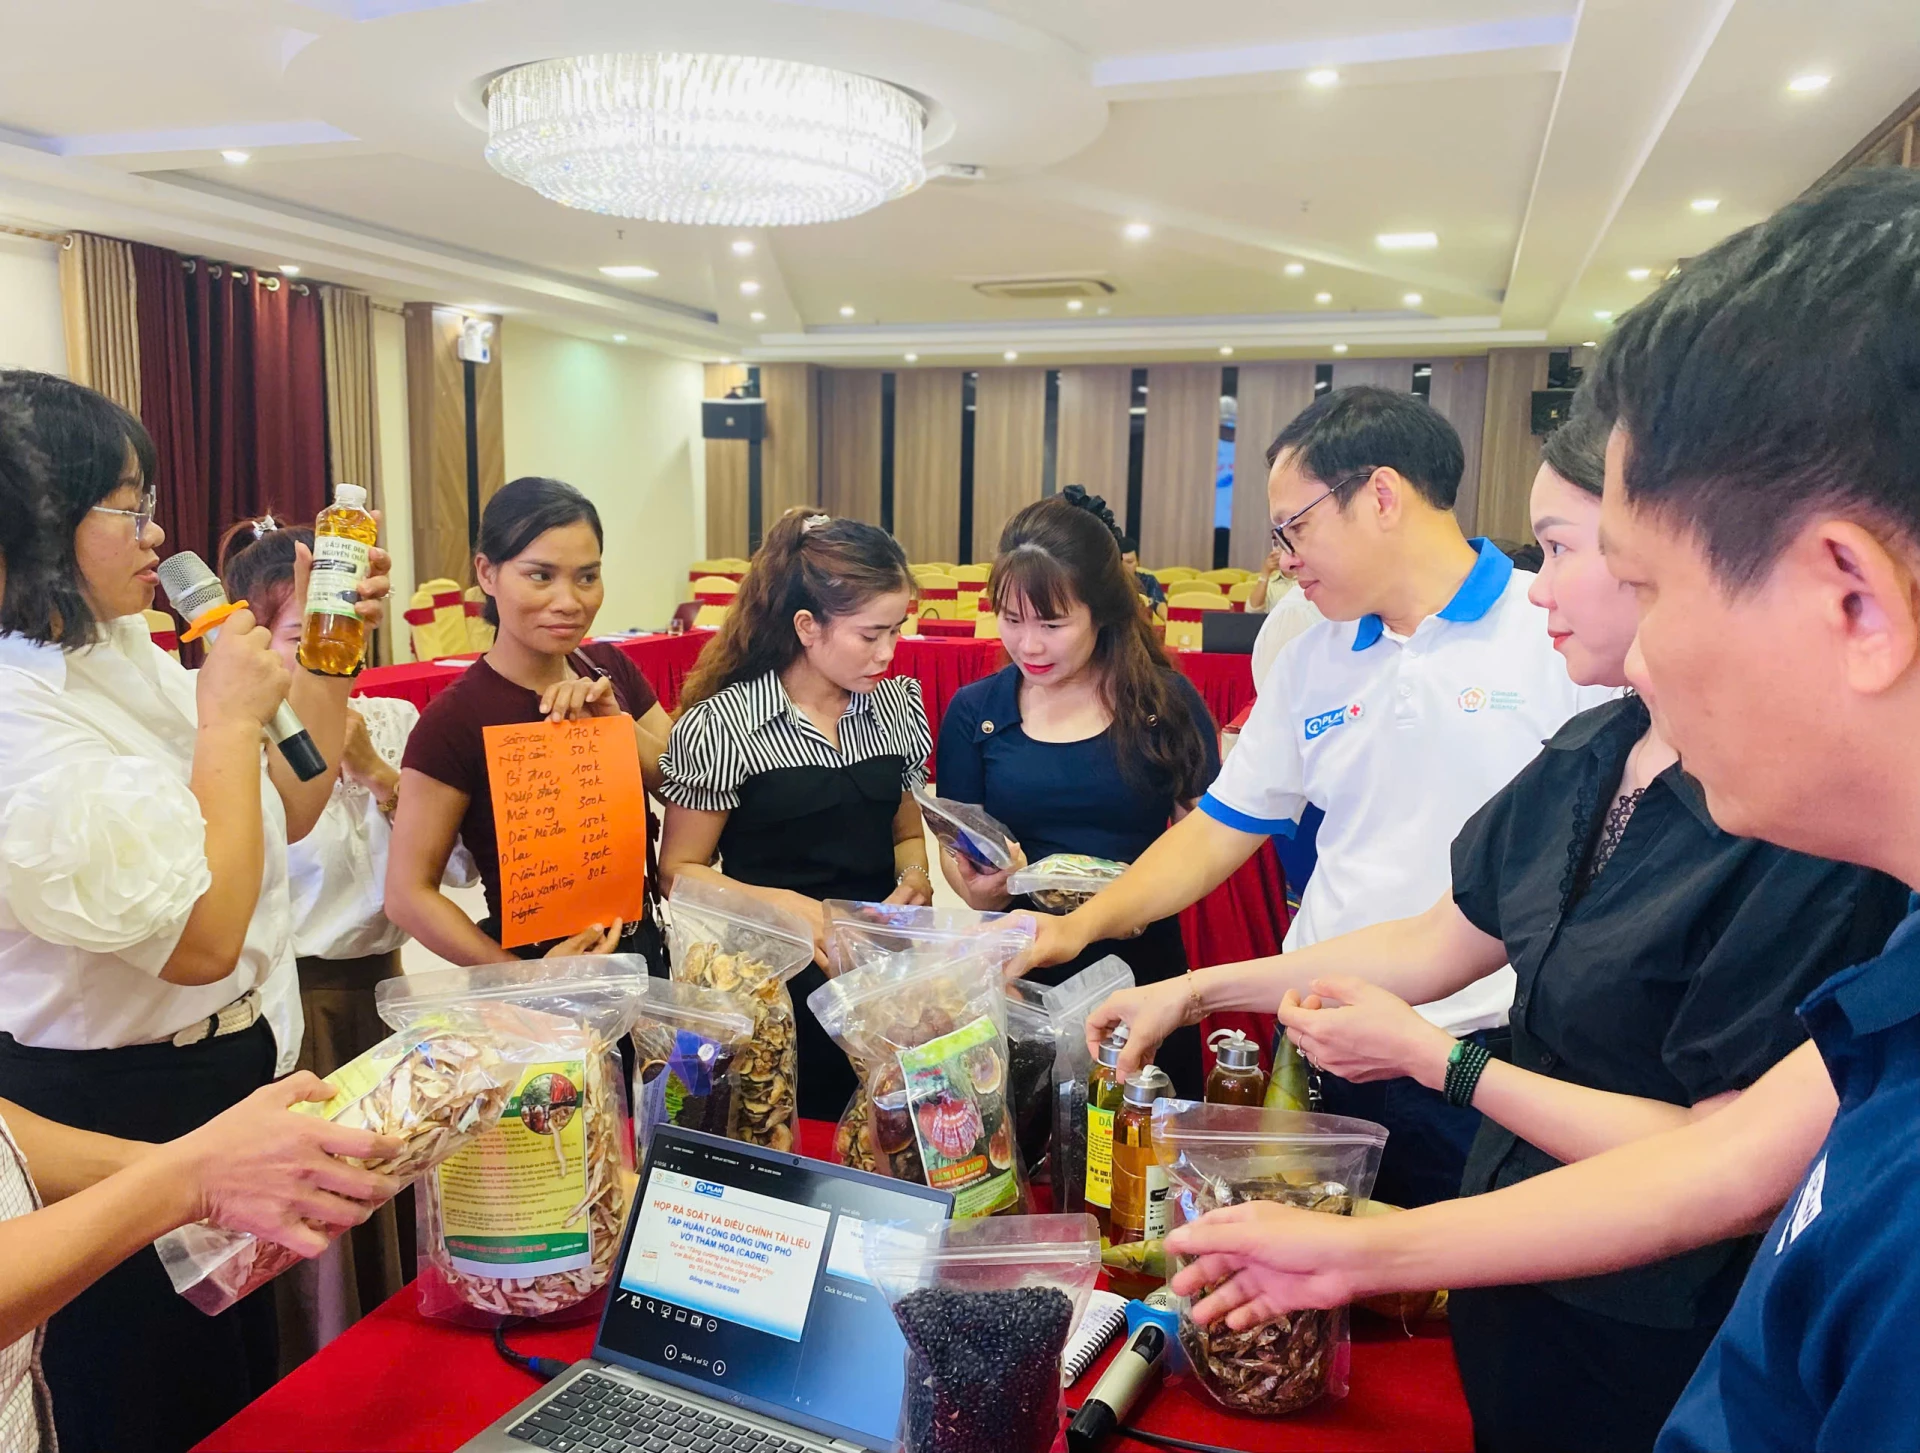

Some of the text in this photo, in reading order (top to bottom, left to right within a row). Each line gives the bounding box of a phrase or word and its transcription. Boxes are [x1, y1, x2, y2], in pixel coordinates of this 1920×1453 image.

[706, 1186, 723, 1194] PLAN
[653, 1200, 672, 1212] HỌP
[718, 1240, 735, 1254] HỌA
[736, 1245, 770, 1264] (CADRE)
[824, 1285, 837, 1295] Click
[842, 1291, 853, 1299] add
[853, 1293, 867, 1303] notes
[681, 1352, 693, 1361] Slide
[702, 1359, 709, 1367] 52
